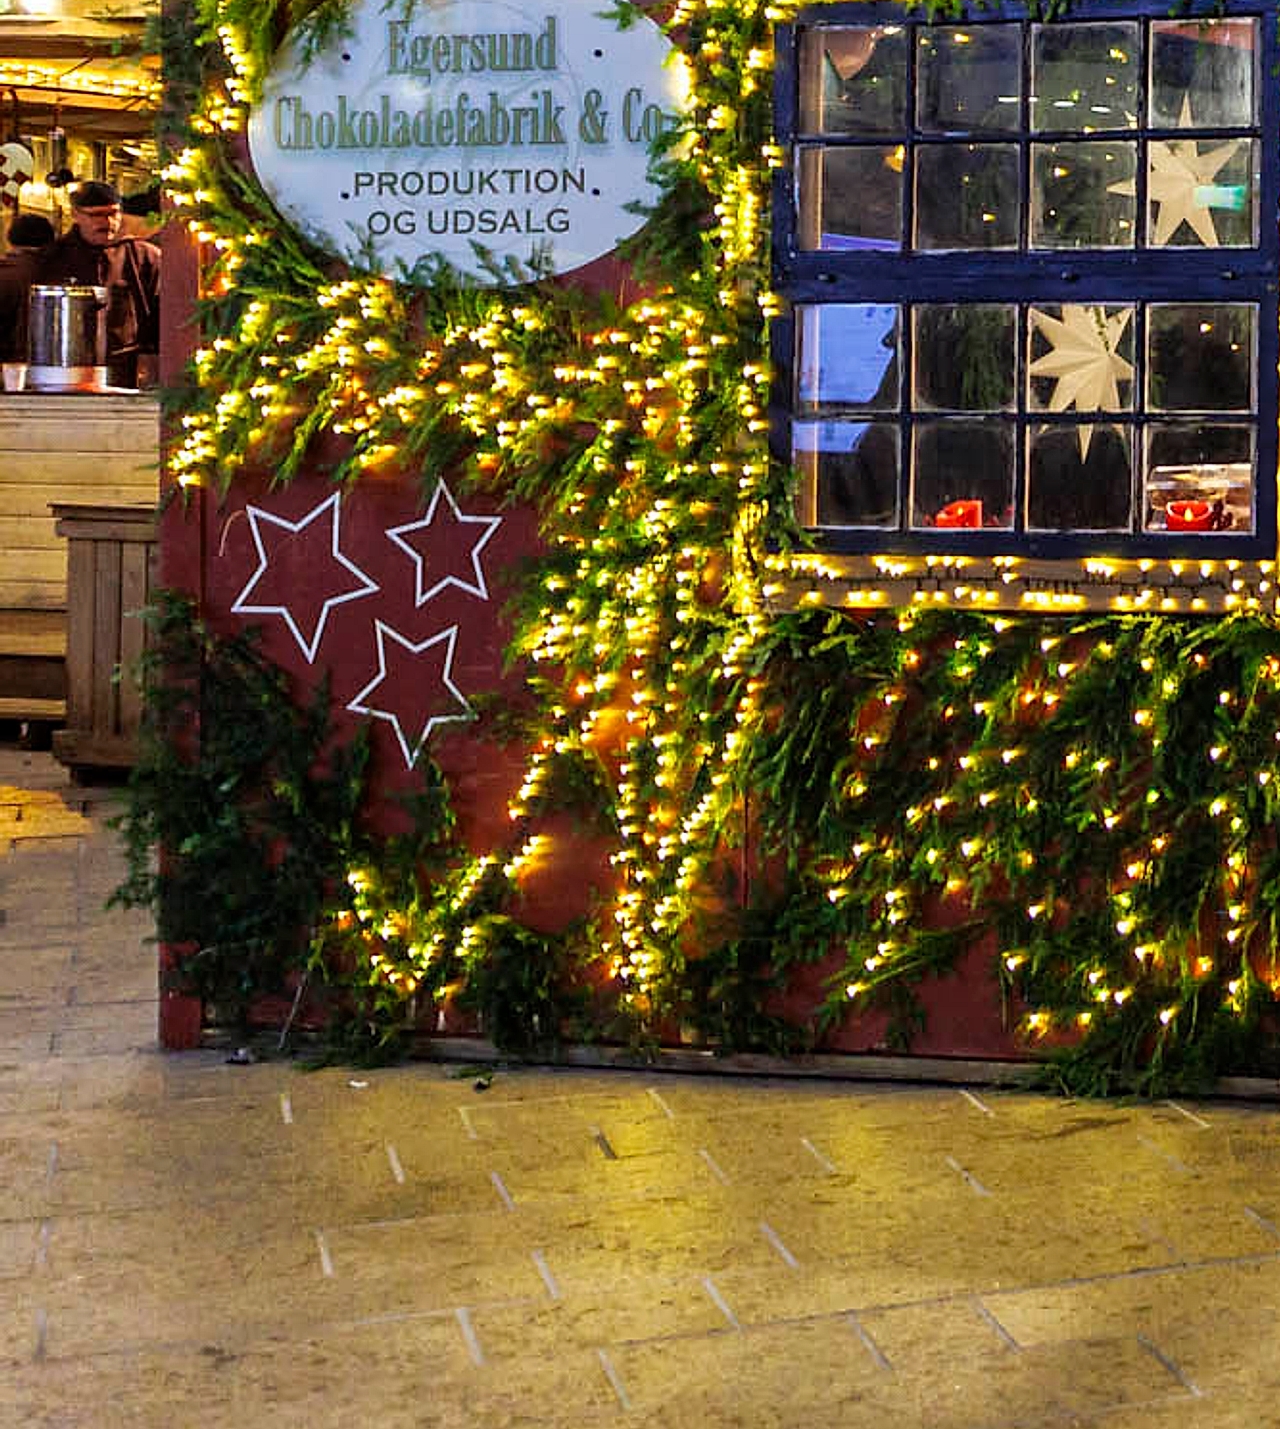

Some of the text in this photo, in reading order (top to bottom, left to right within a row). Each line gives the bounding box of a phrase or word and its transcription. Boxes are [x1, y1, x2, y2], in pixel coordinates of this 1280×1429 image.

[388, 17, 558, 82] Egersund
[274, 91, 569, 152] Chokoladefabrik
[578, 88, 609, 144] &
[353, 168, 586, 197] PRODUKTION
[366, 208, 571, 236] OG UDSALG
